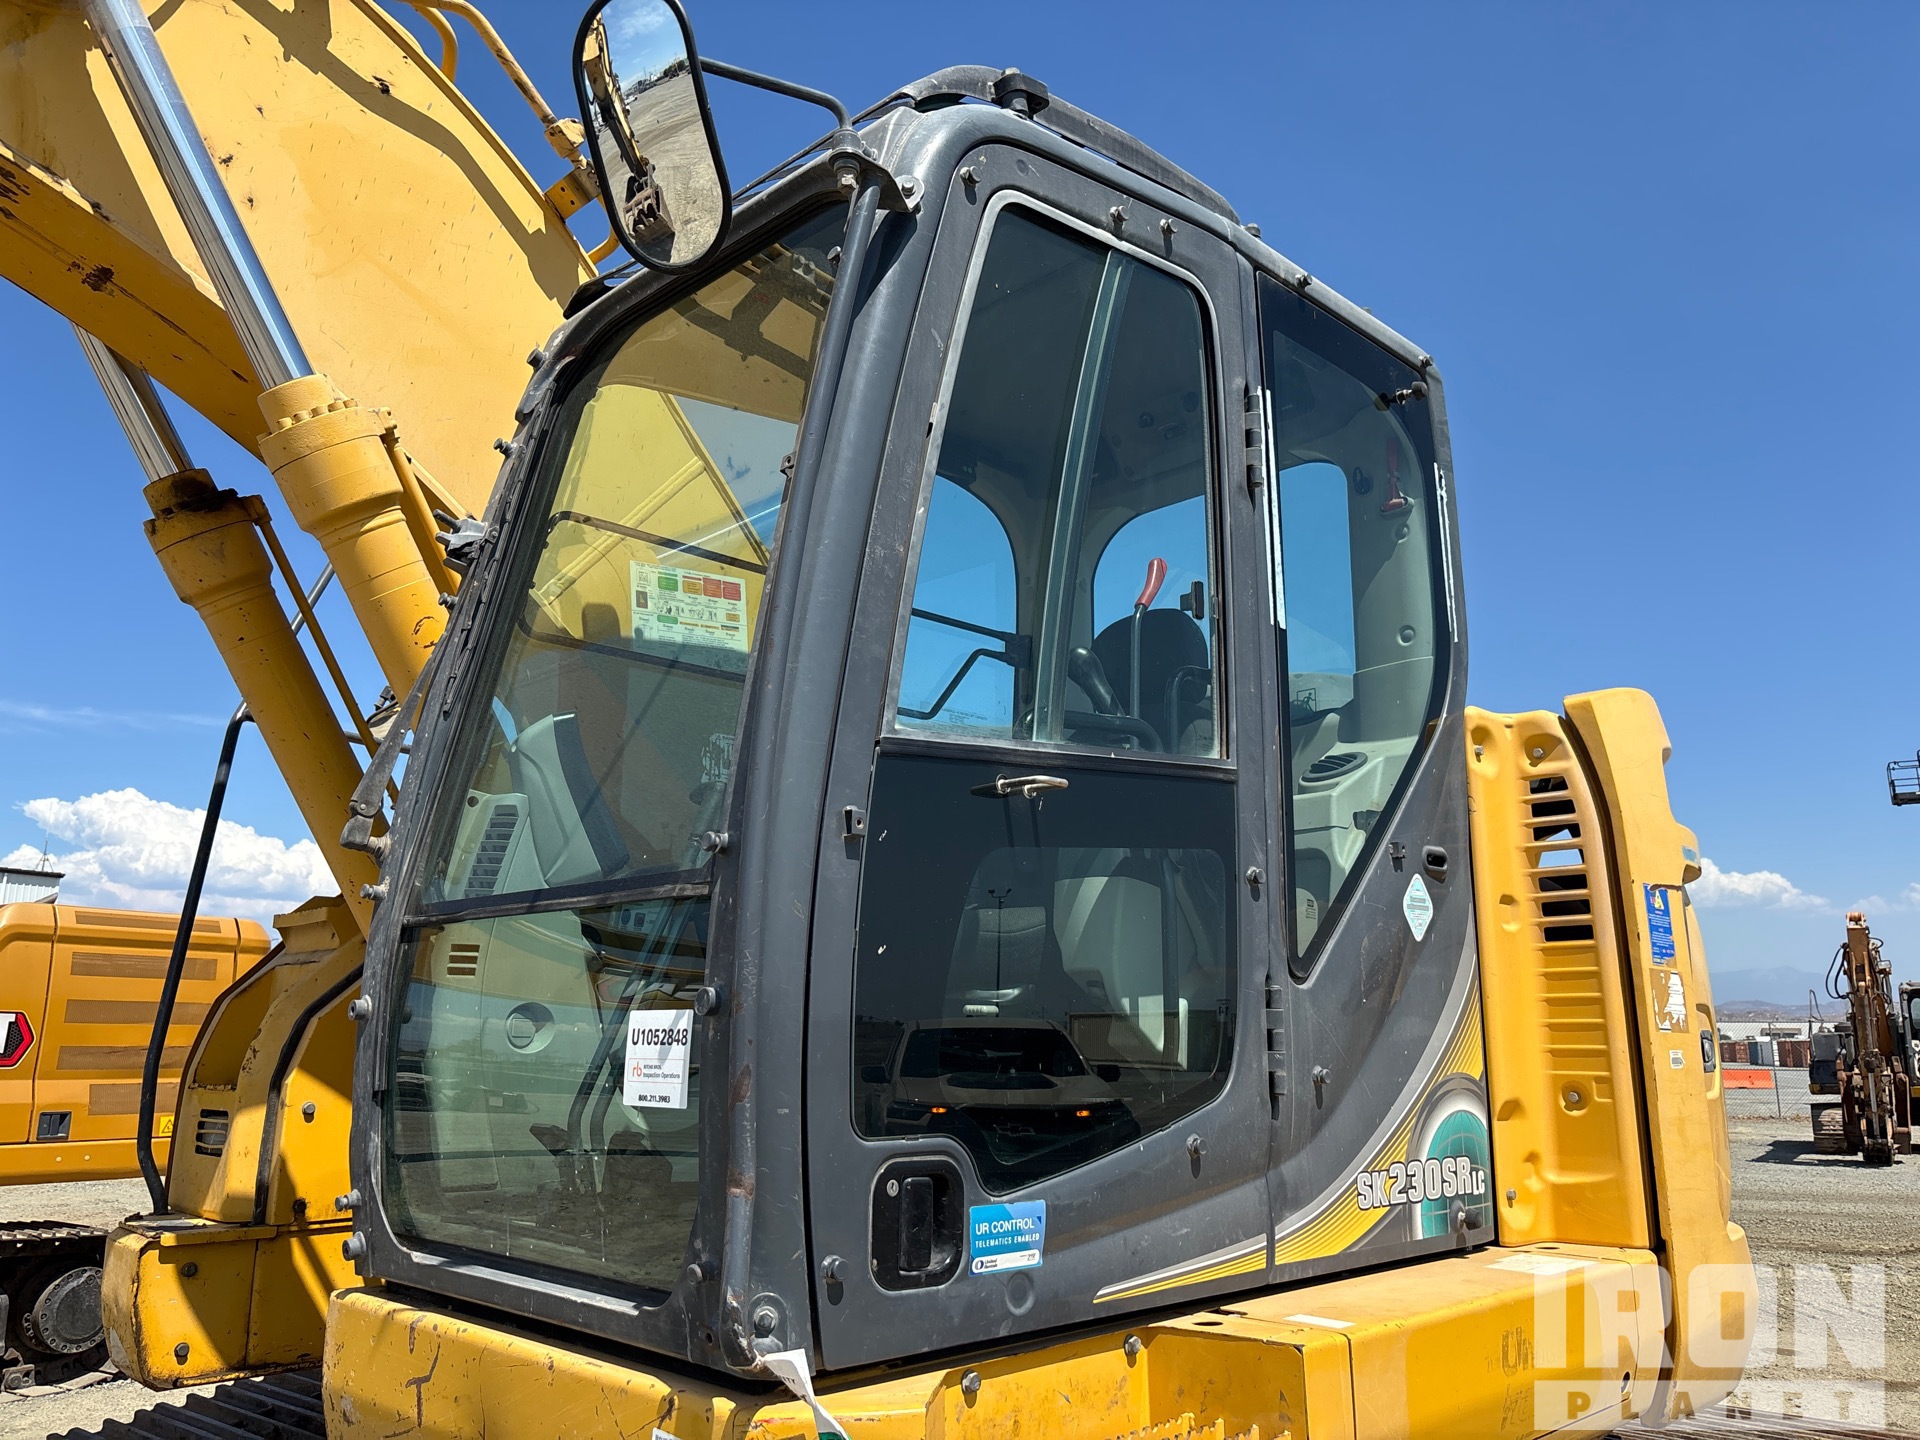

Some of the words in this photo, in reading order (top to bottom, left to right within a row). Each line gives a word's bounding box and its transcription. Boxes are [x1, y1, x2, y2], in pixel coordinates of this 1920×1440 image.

[631, 1028, 688, 1046] U1052848
[638, 1094, 671, 1103] 800.211.3983
[975, 1222, 989, 1235] UR
[991, 1218, 1034, 1233] CONTROL
[975, 1237, 1012, 1248] TELEMATICS
[1014, 1233, 1040, 1243] ENABLED
